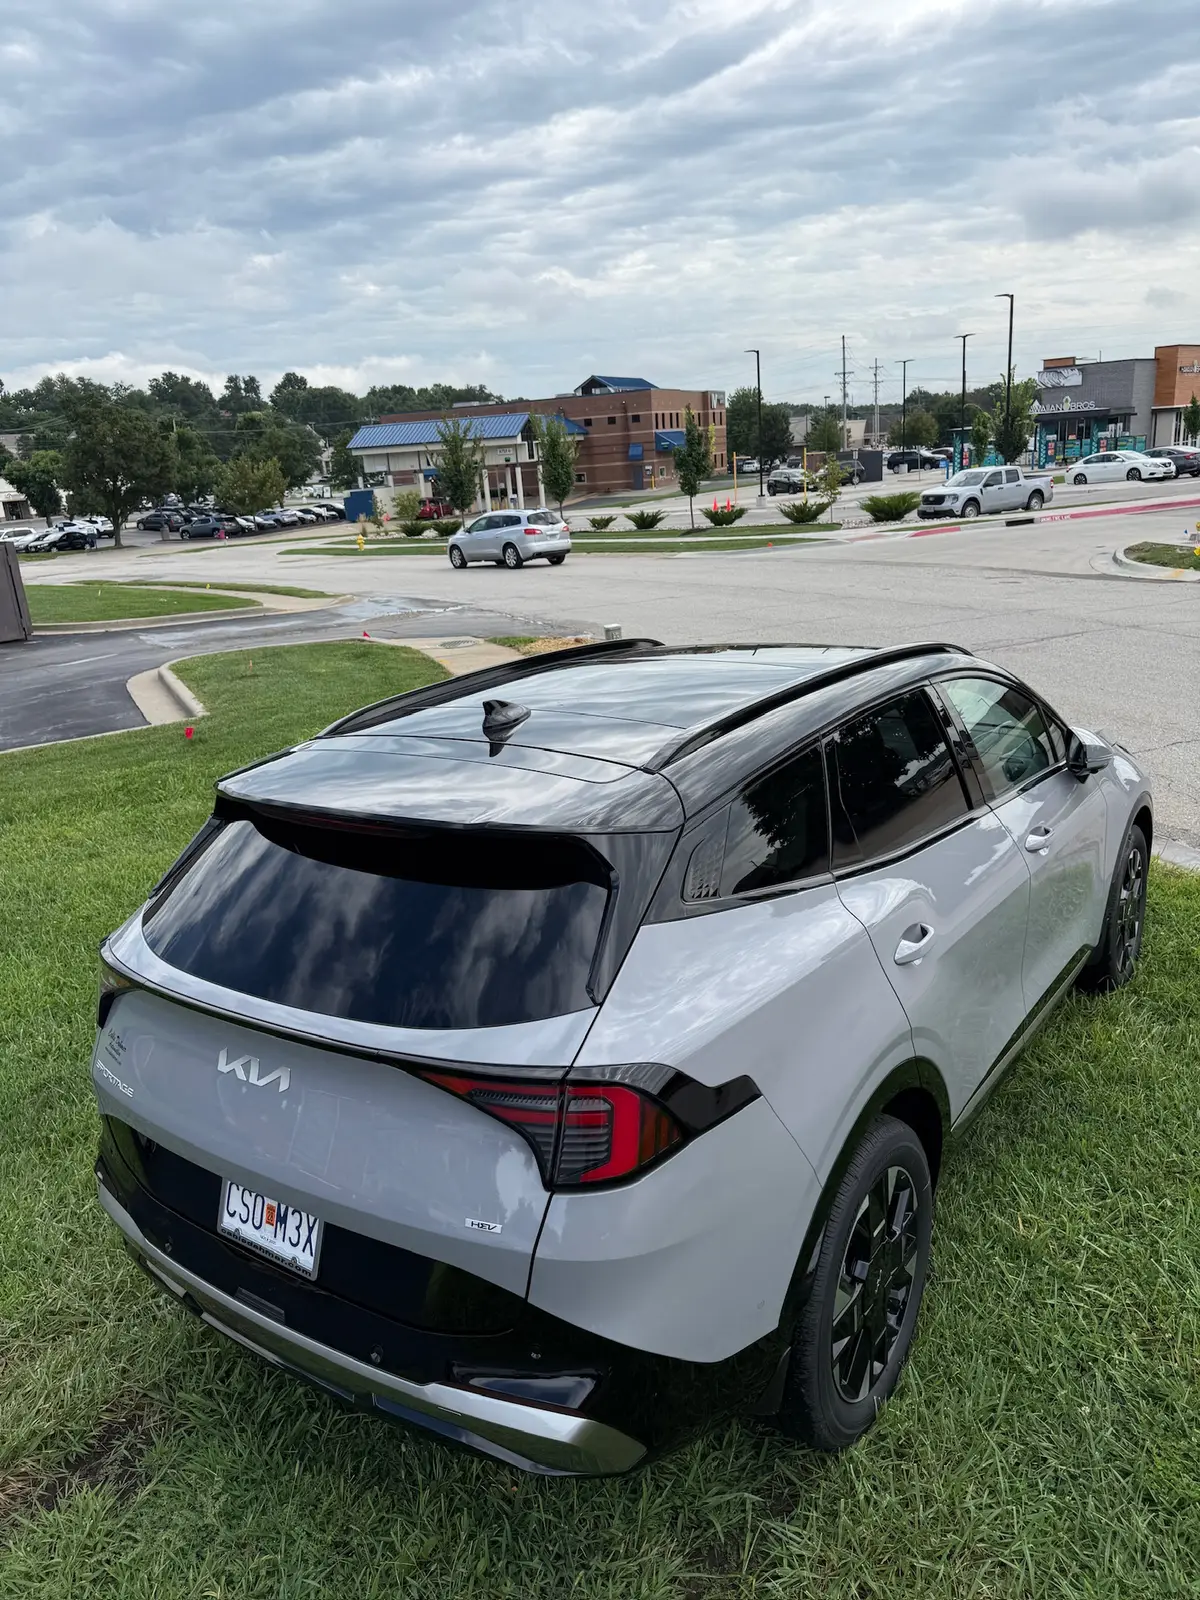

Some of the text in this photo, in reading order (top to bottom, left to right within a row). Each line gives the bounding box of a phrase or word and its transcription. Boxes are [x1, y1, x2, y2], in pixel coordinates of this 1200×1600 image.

[1070, 400, 1096, 411] BROS
[95, 1058, 135, 1098] SPORTAGE
[217, 1046, 291, 1093] KIA
[273, 1202, 318, 1257] M3X
[470, 1220, 498, 1231] HEV
